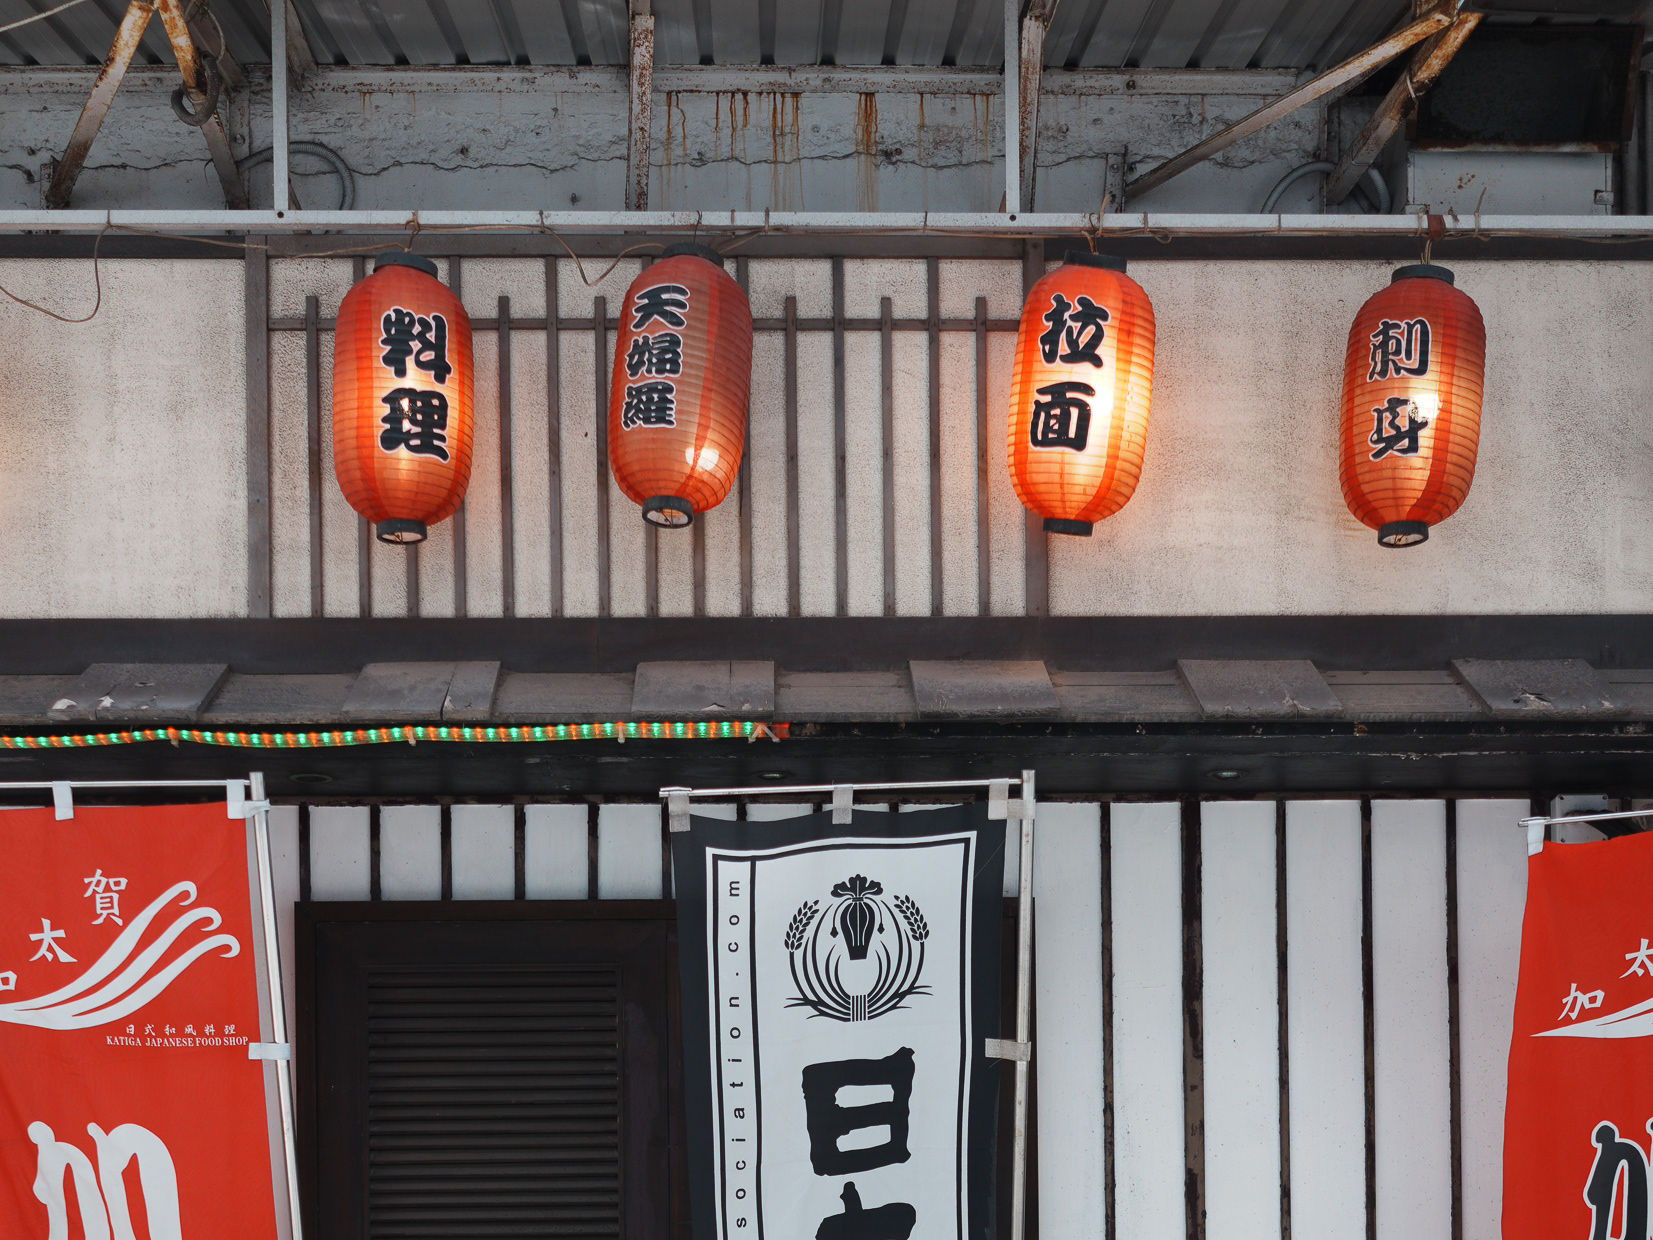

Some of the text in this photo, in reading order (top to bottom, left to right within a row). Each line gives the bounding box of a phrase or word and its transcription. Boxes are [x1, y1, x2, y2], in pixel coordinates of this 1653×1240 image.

[379, 307, 452, 463] 料理
[622, 284, 690, 430] 天婦羅
[1030, 293, 1110, 453] 拉面
[1367, 317, 1431, 461] 刺身
[106, 1036, 249, 1047] KATIGA JAPANESE FOOD SHOP
